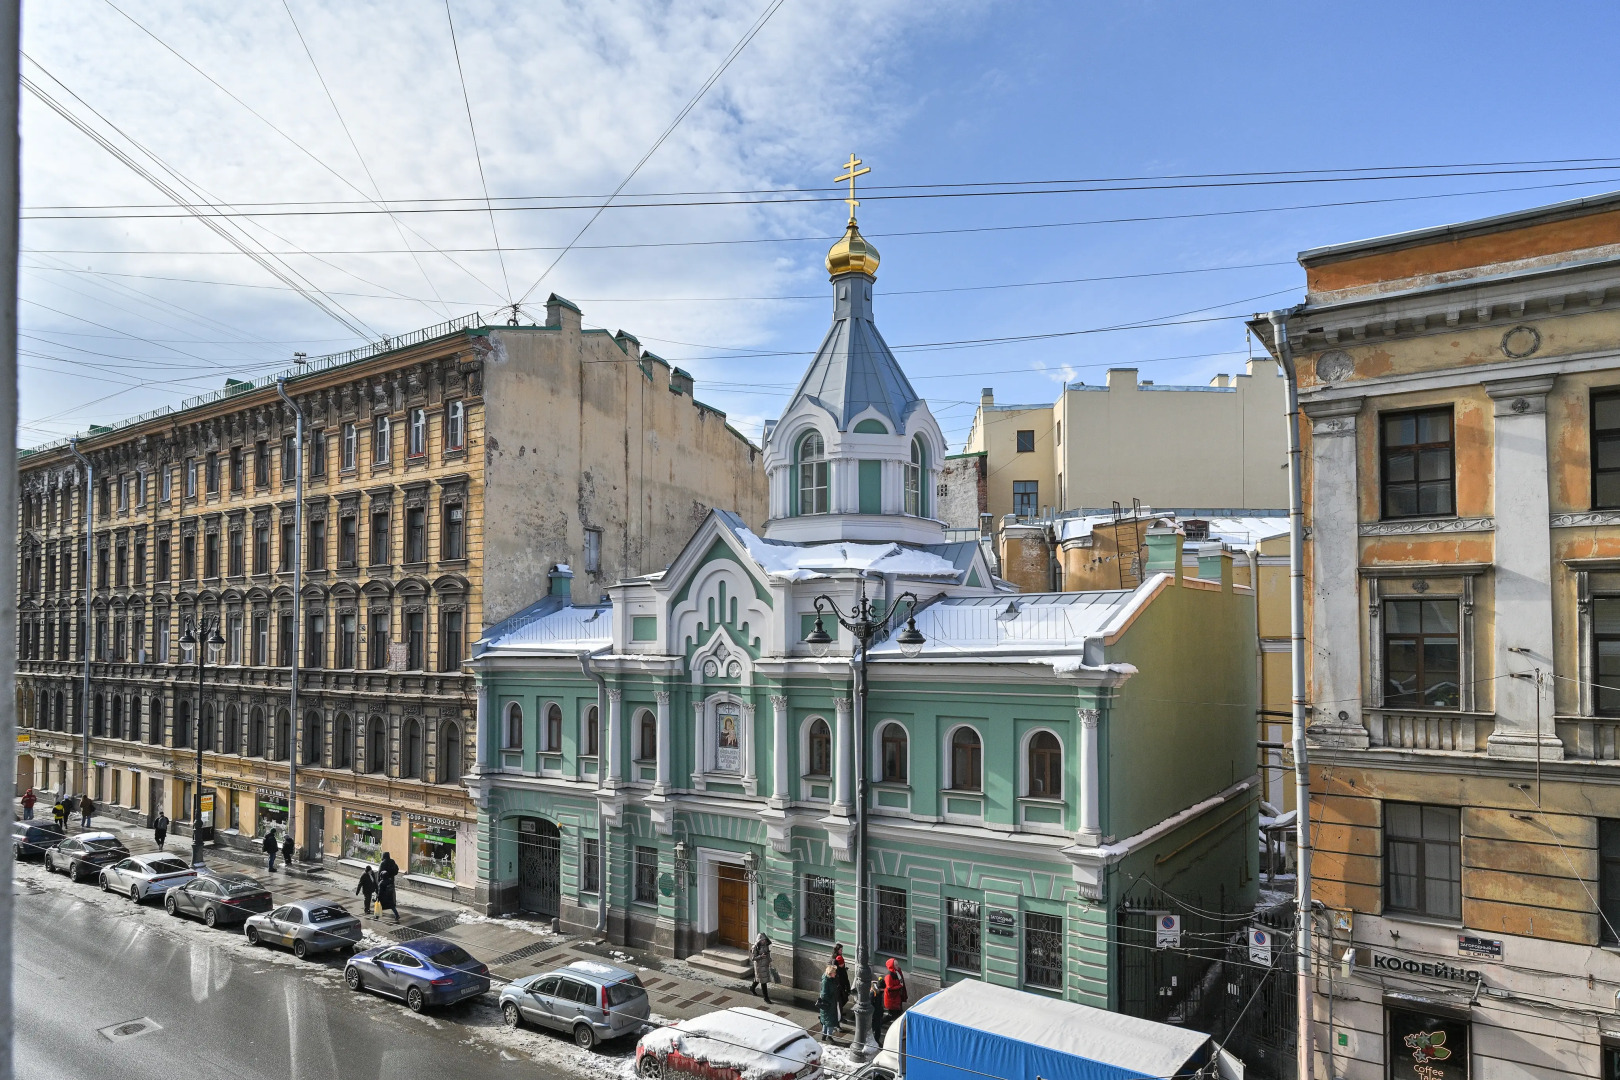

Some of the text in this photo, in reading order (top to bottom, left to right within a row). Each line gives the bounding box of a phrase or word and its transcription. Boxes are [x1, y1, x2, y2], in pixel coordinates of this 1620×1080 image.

[1460, 942, 1491, 950] ЗАГОРОДНЫЙ
[1374, 955, 1480, 983] КОФЕЙНЯ
[1413, 1064, 1444, 1077] Coffee
